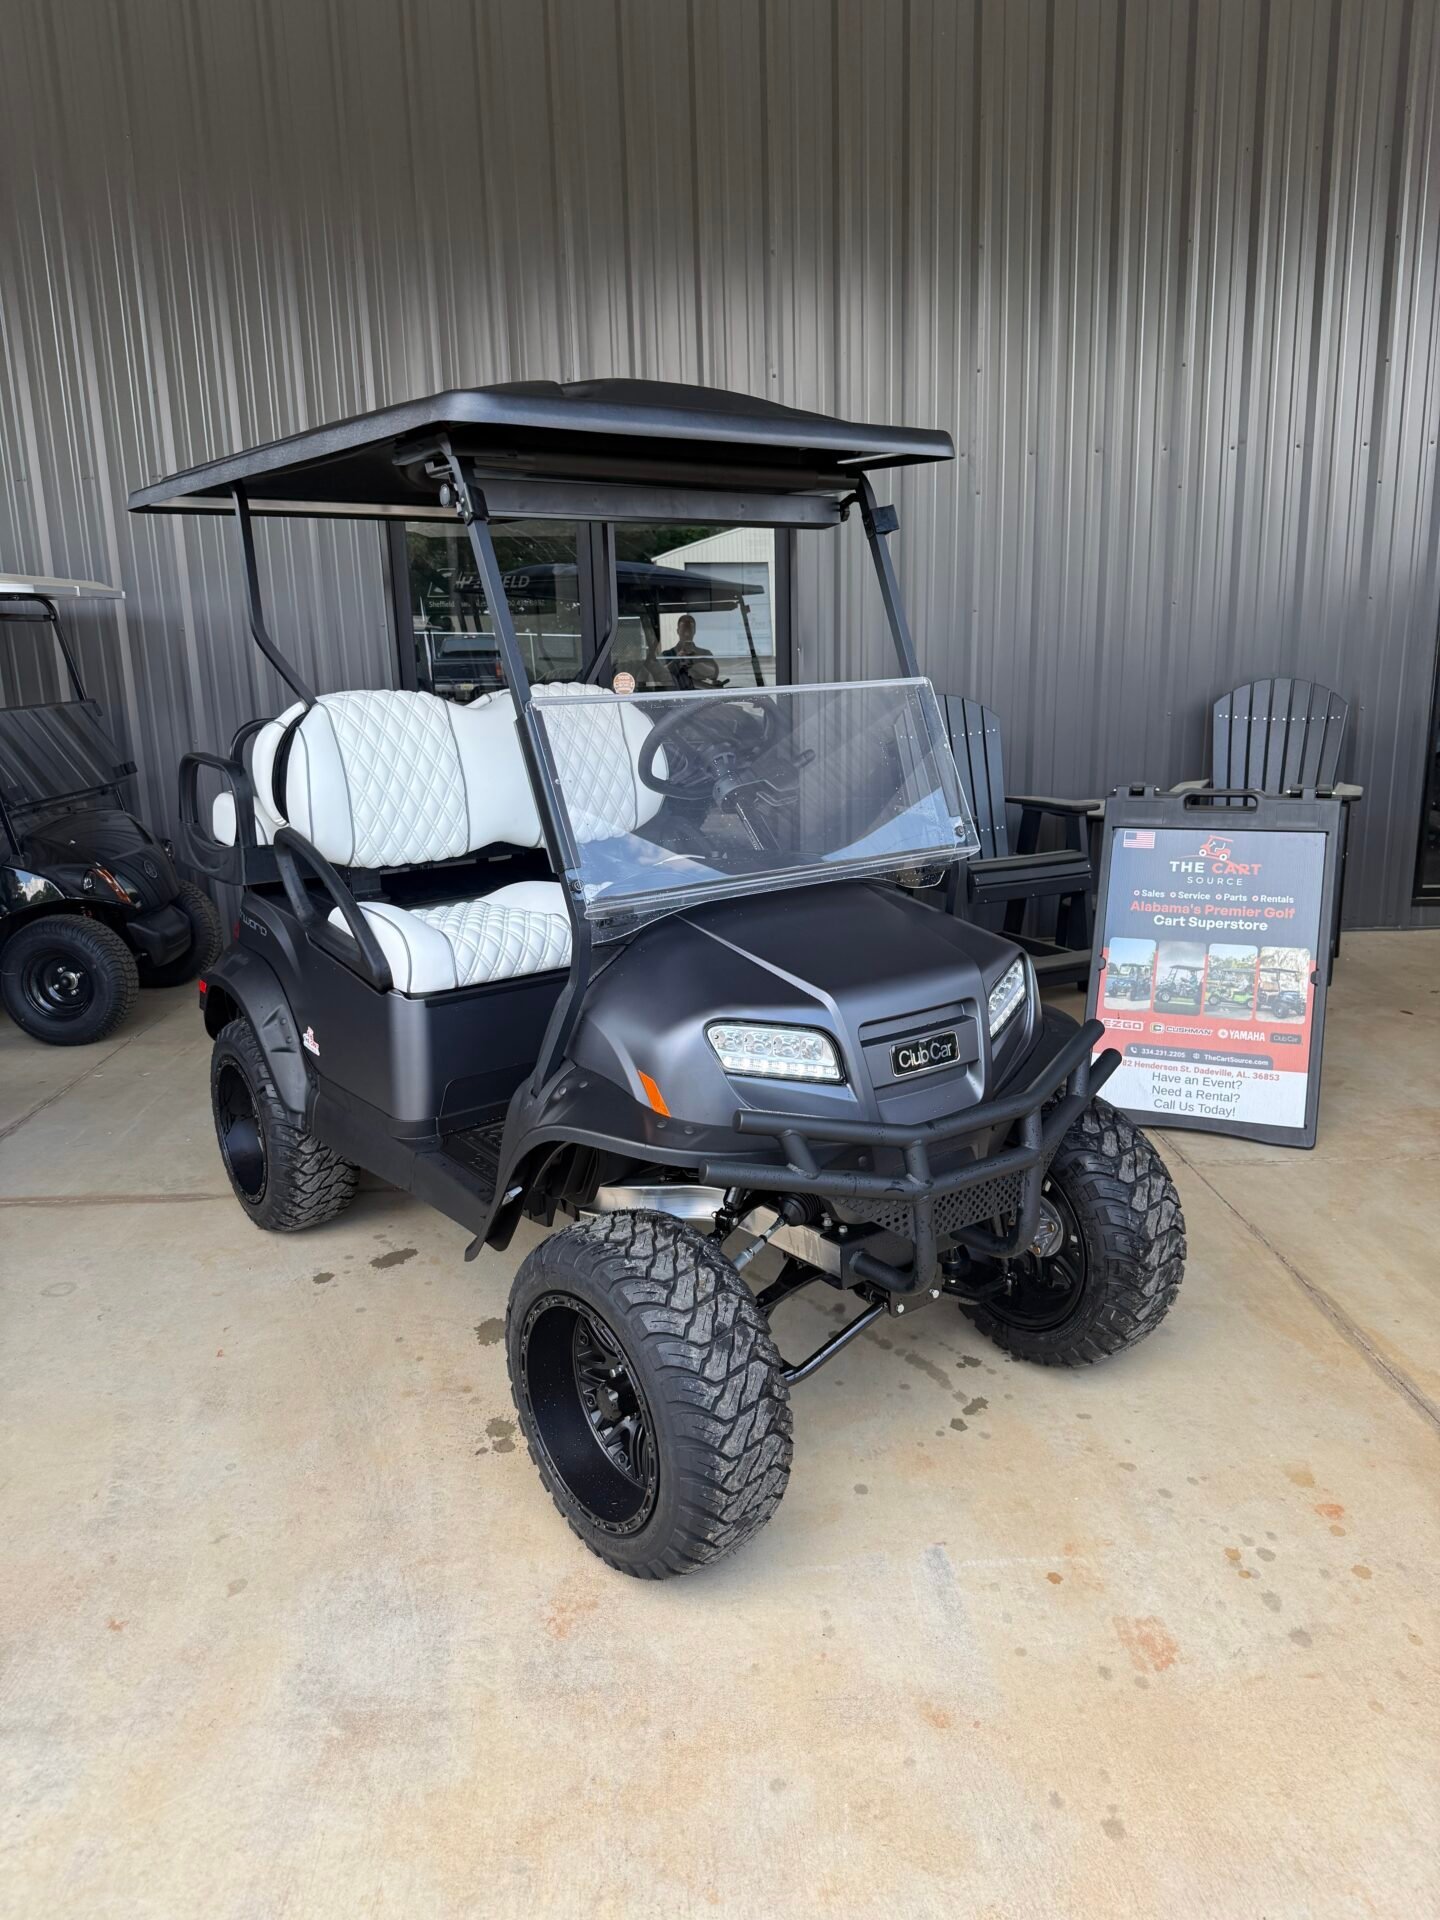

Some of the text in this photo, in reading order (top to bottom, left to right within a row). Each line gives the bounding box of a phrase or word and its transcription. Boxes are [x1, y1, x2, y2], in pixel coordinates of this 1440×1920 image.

[1169, 861, 1263, 876] THE CART
[1187, 876, 1243, 886] SOURCE
[1141, 889, 1294, 904] Sales Service Parts Rentals
[1130, 900, 1296, 919] Alabama's Premier Golf
[1153, 914, 1268, 931] Cart Superstore
[1103, 1019, 1142, 1029] EZGO
[1166, 1026, 1212, 1035] CUSHMAN
[1229, 1029, 1266, 1042] YAMAHA
[1204, 1054, 1269, 1065] TheCartSource.com
[1134, 1060, 1178, 1071] Henderson
[1179, 1065, 1192, 1073] St.
[1194, 1067, 1234, 1078] Dadeville,
[1236, 1071, 1250, 1079] AL.
[1252, 1072, 1280, 1081] 36853
[1152, 1072, 1243, 1090] Have an Event?
[1152, 1085, 1240, 1103] Need a Rental?
[1154, 1098, 1236, 1118] Call Us Today!
